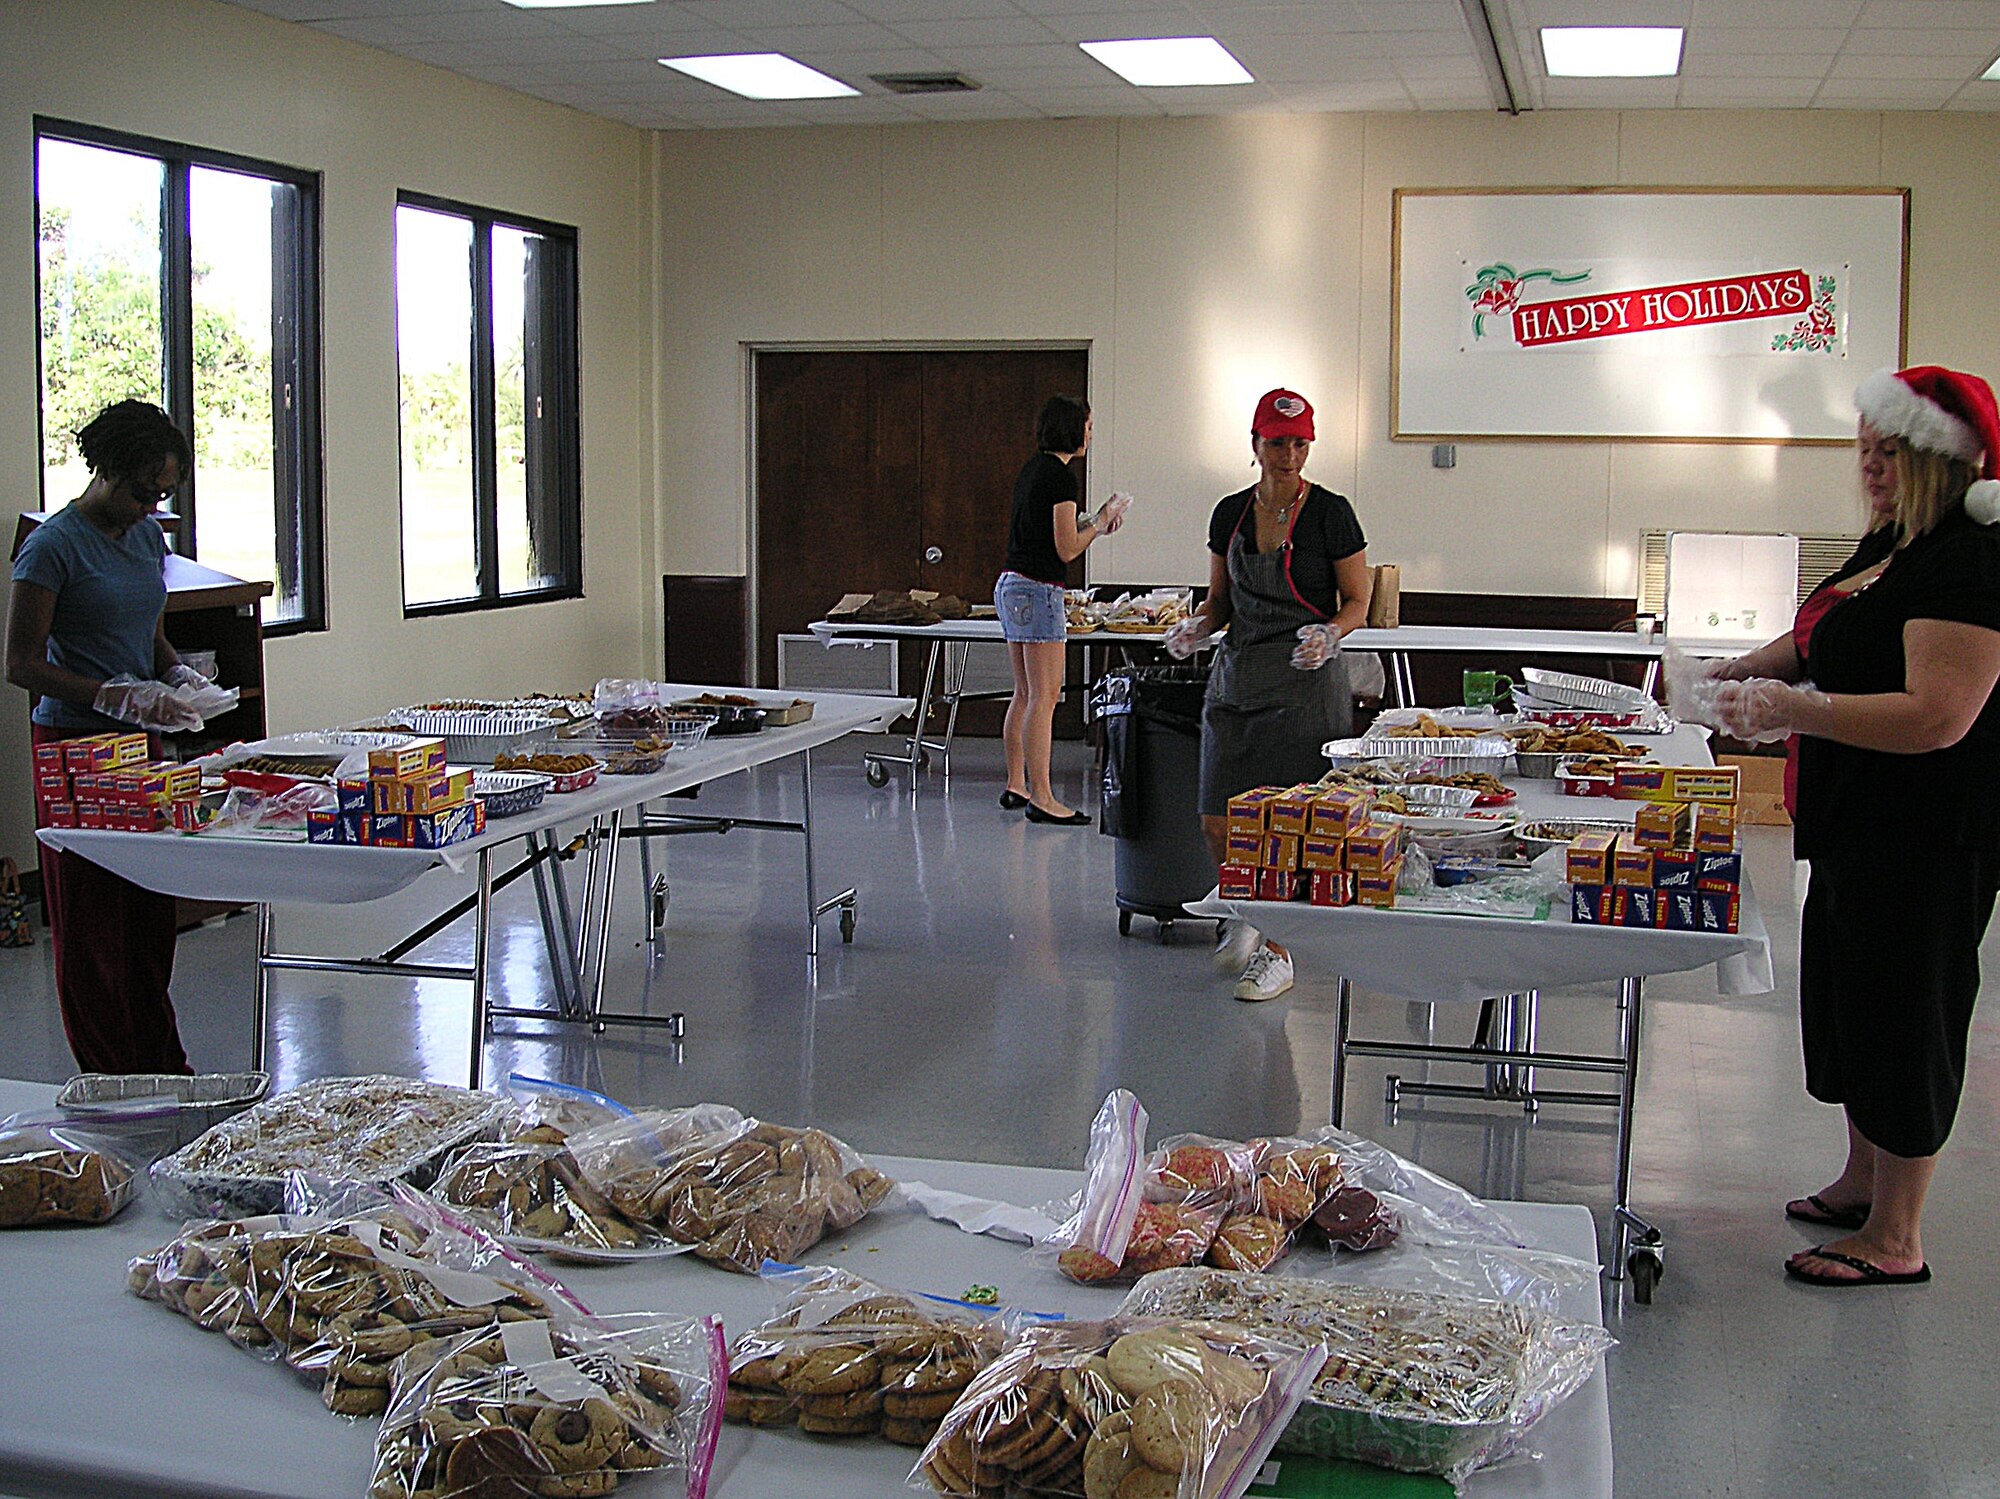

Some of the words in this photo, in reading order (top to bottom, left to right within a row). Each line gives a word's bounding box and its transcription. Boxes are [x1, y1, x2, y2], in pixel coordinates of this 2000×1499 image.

[1519, 297, 1631, 341] HAPPY
[1641, 275, 1804, 326] HOLIDAYS
[441, 807, 468, 845] Ziploc
[1703, 856, 1734, 872] Ziploc
[1660, 871, 1690, 886] Ziploc
[1576, 891, 1592, 920] Ziploc
[1634, 893, 1650, 921] Ziploc
[1677, 896, 1692, 924] Ziploc
[1702, 900, 1718, 928] Ziploc
